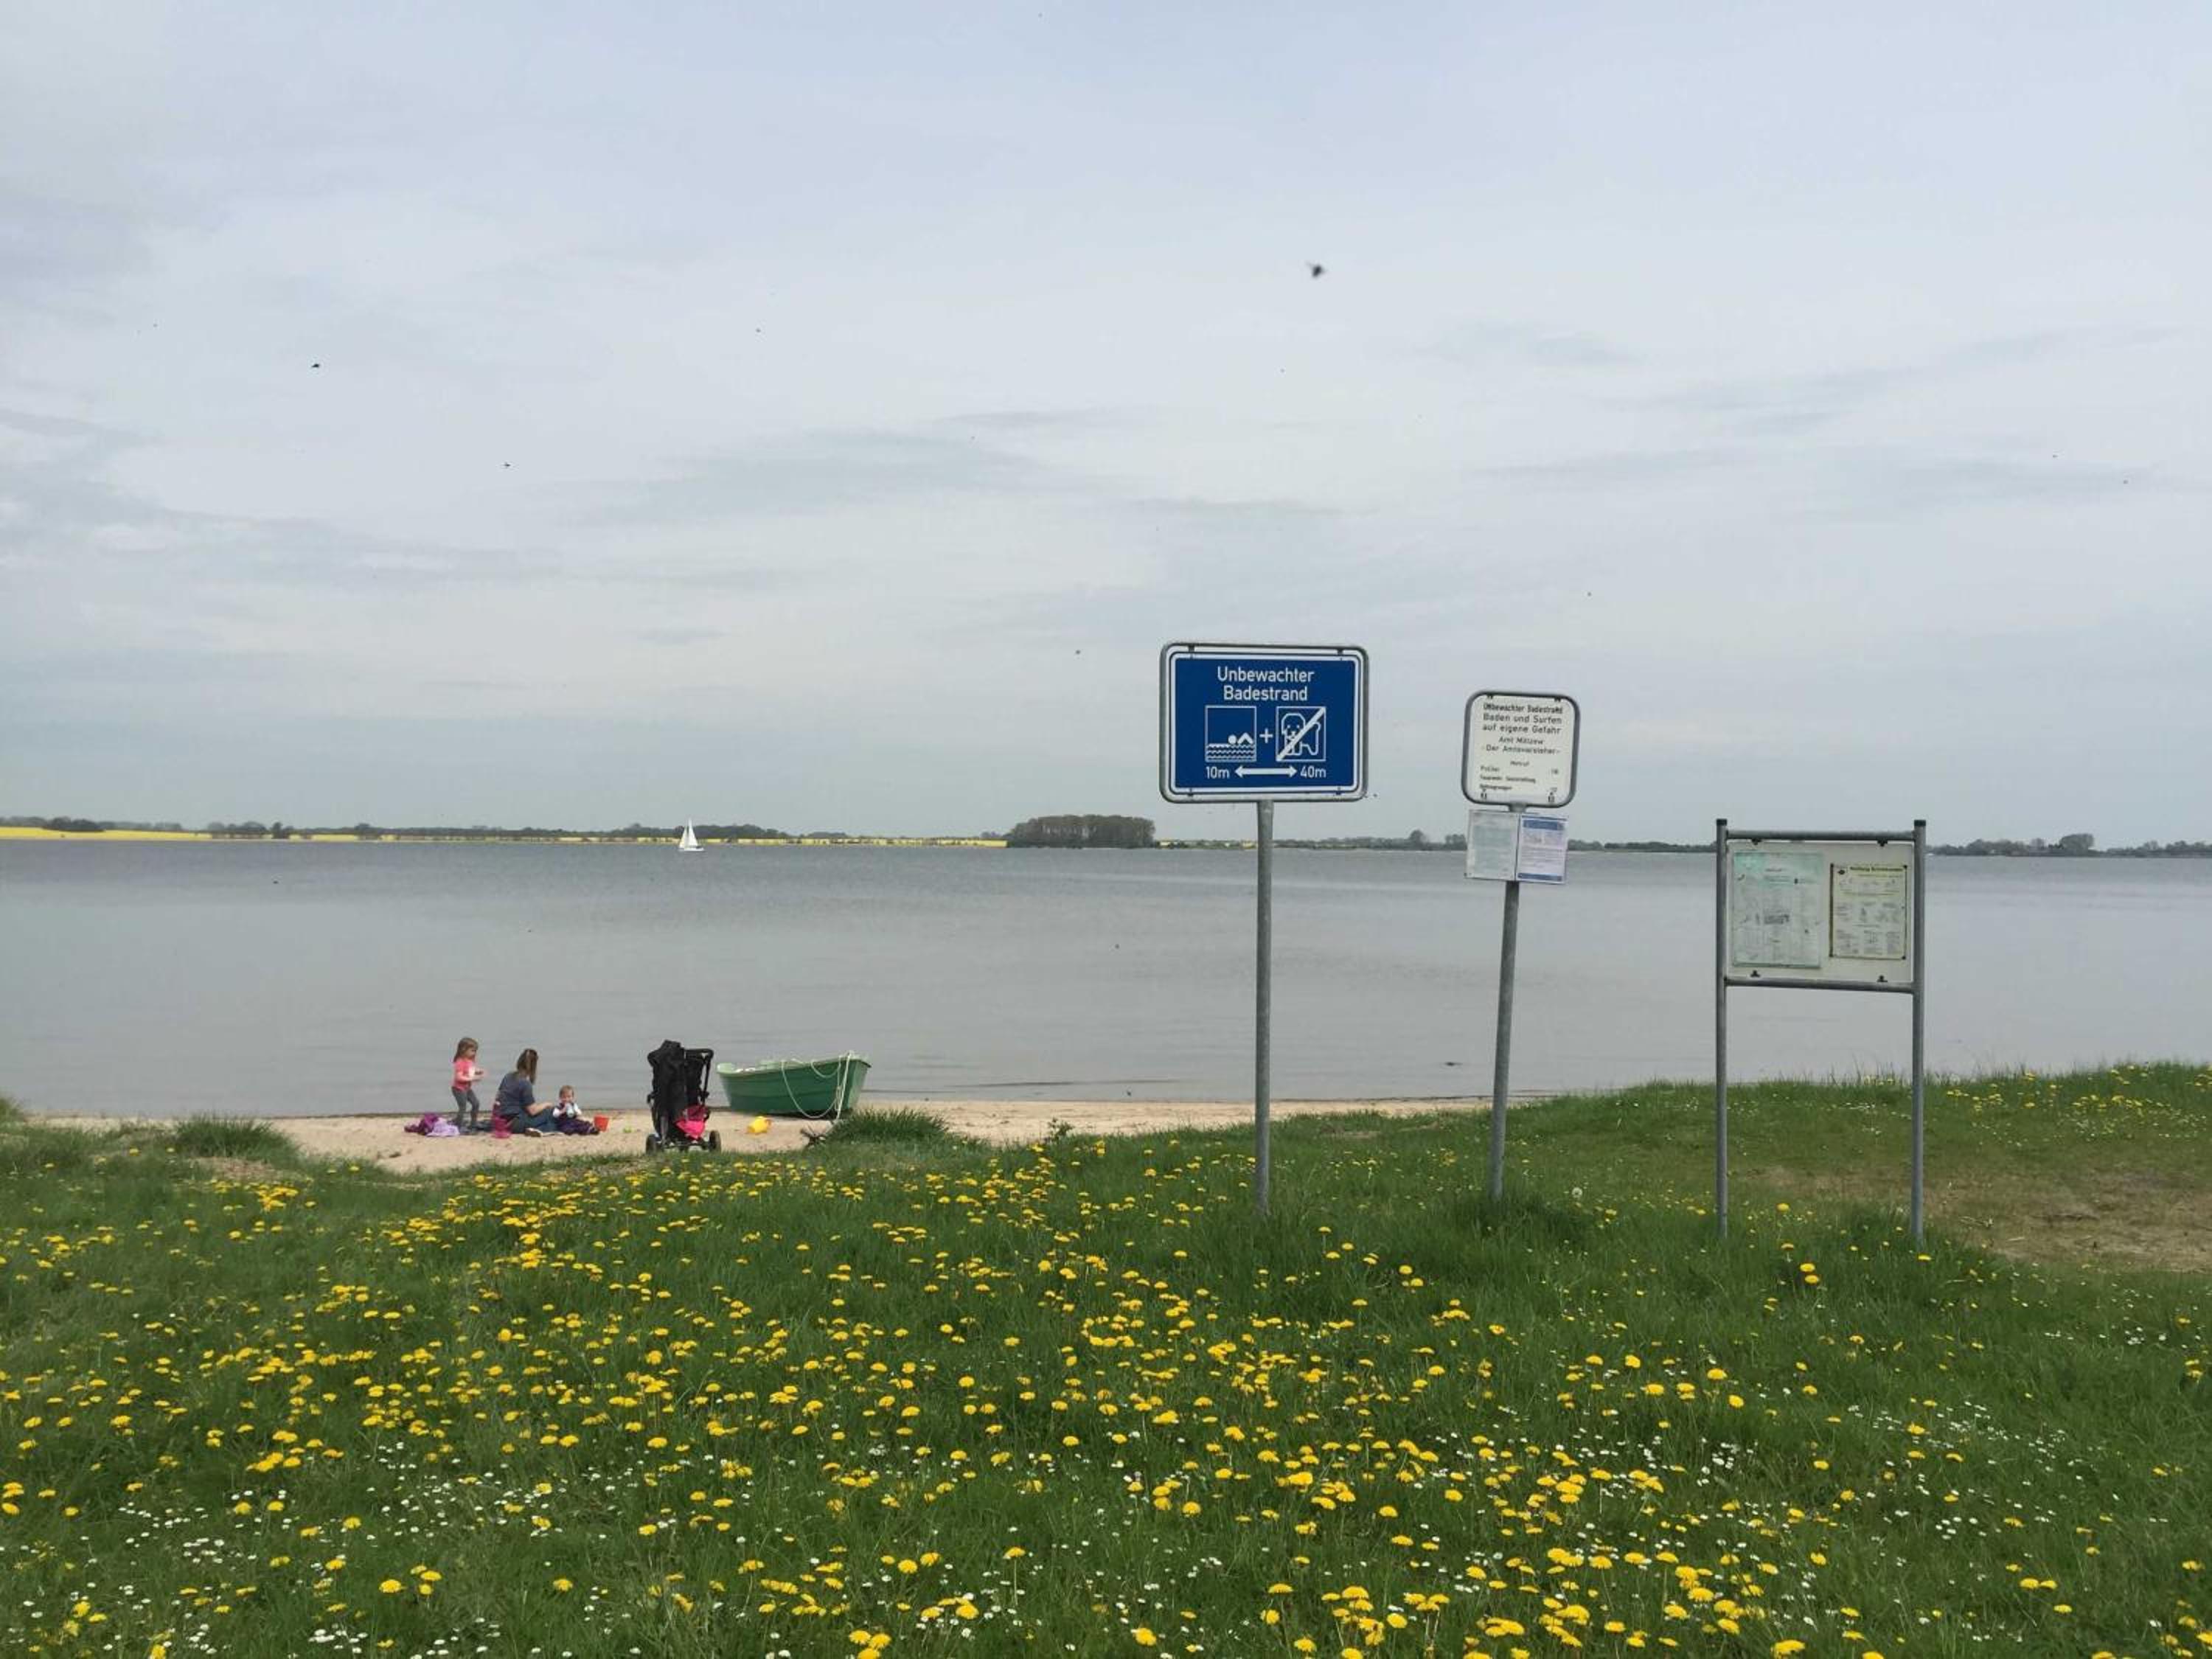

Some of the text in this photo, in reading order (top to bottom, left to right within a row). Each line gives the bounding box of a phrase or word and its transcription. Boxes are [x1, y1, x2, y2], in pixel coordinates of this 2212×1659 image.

[1217, 667, 1315, 683] Unbewachter
[1223, 686, 1307, 701] Badestrand
[1483, 713, 1562, 724] Baden und Surfen
[1482, 723, 1562, 734] auf eigene Gefahr
[1206, 766, 1326, 779] 10m 40m
